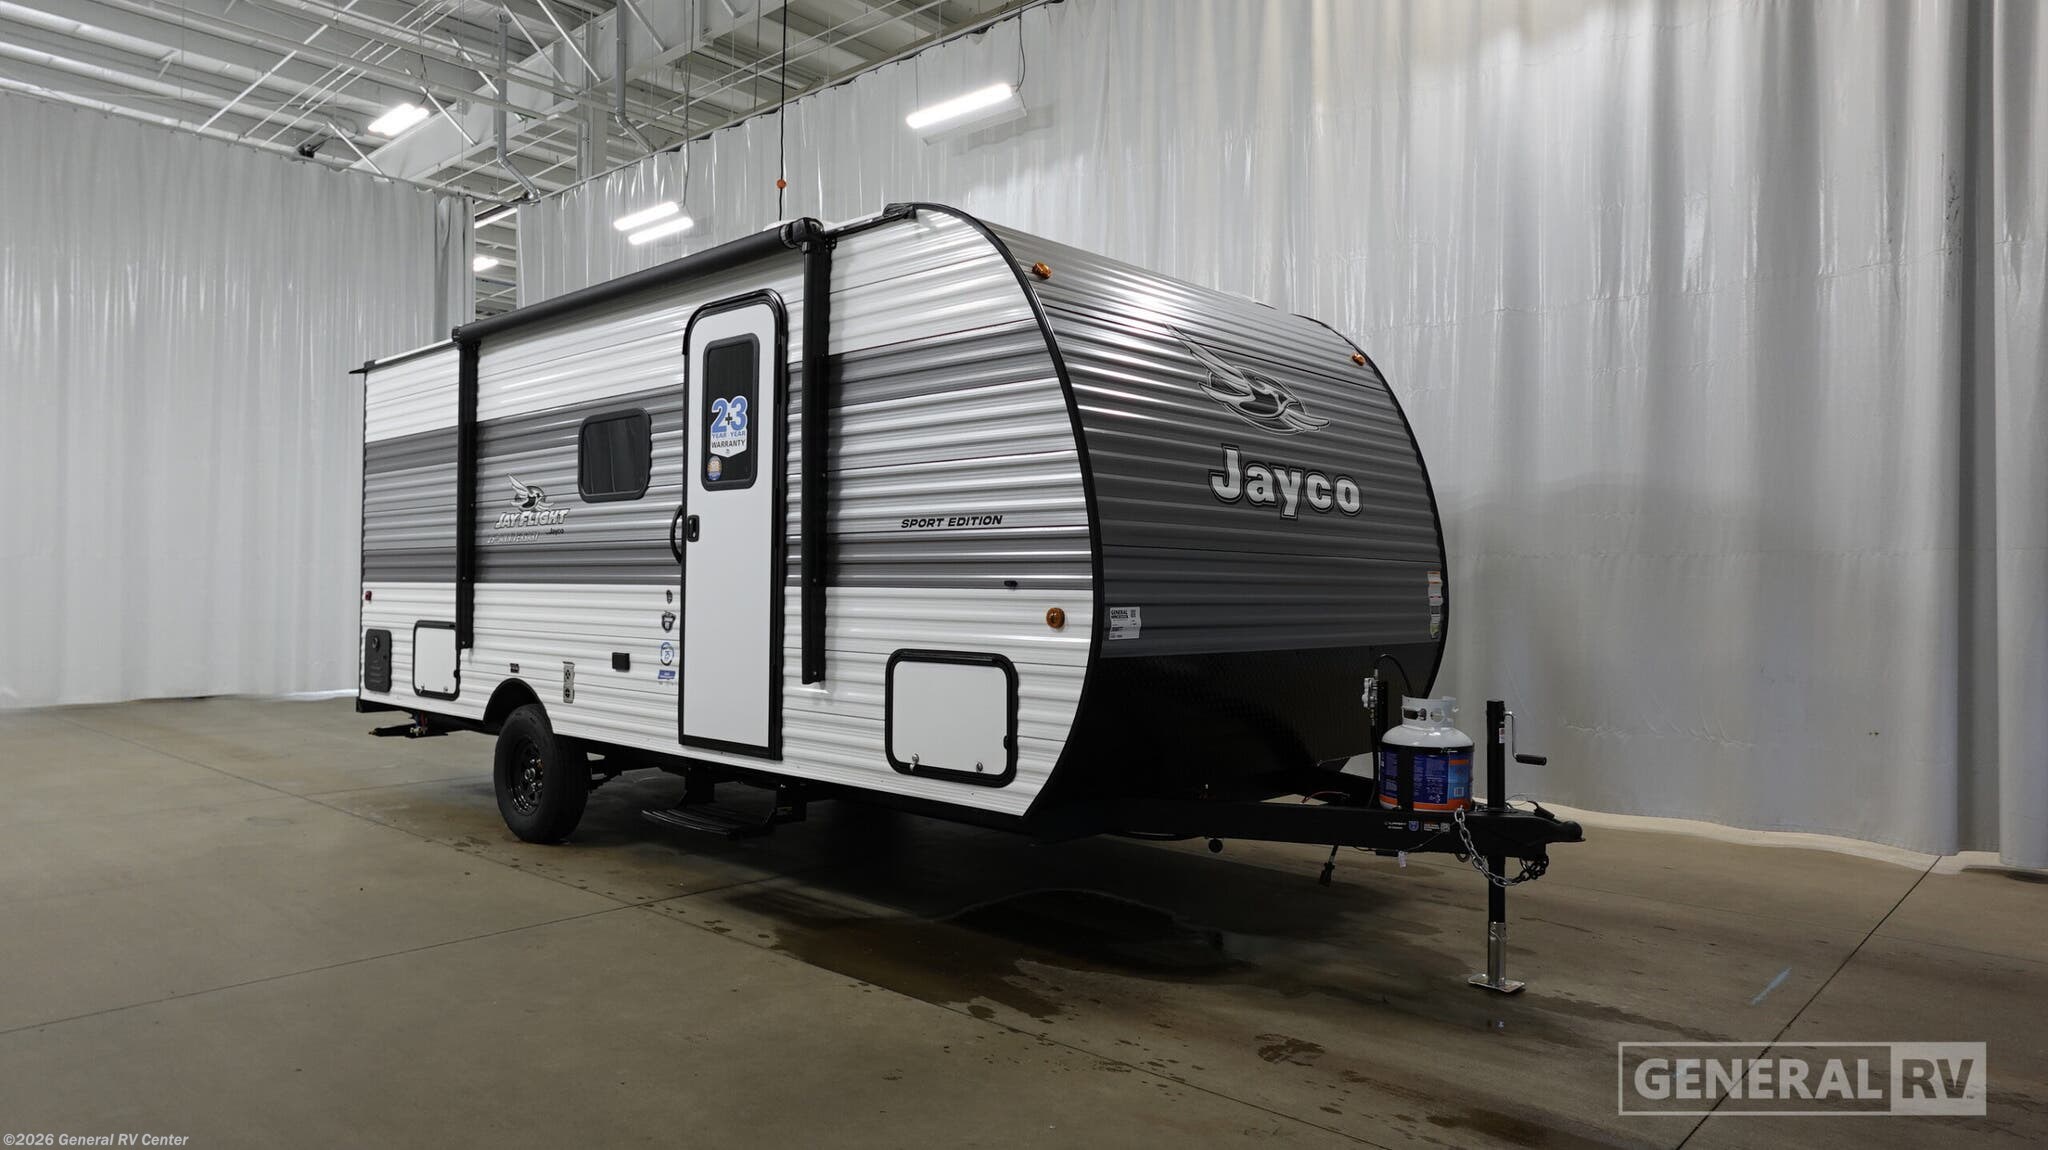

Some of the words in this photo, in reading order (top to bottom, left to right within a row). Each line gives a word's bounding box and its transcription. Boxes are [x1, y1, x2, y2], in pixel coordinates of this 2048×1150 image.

[730, 430, 746, 438] YEAR
[711, 439, 746, 449] WARRANTY
[1208, 443, 1363, 520] Jayco
[494, 512, 520, 529] JAY
[518, 508, 570, 527] FLIGHT
[900, 517, 945, 529] SPORT
[947, 514, 1004, 527] EDITION
